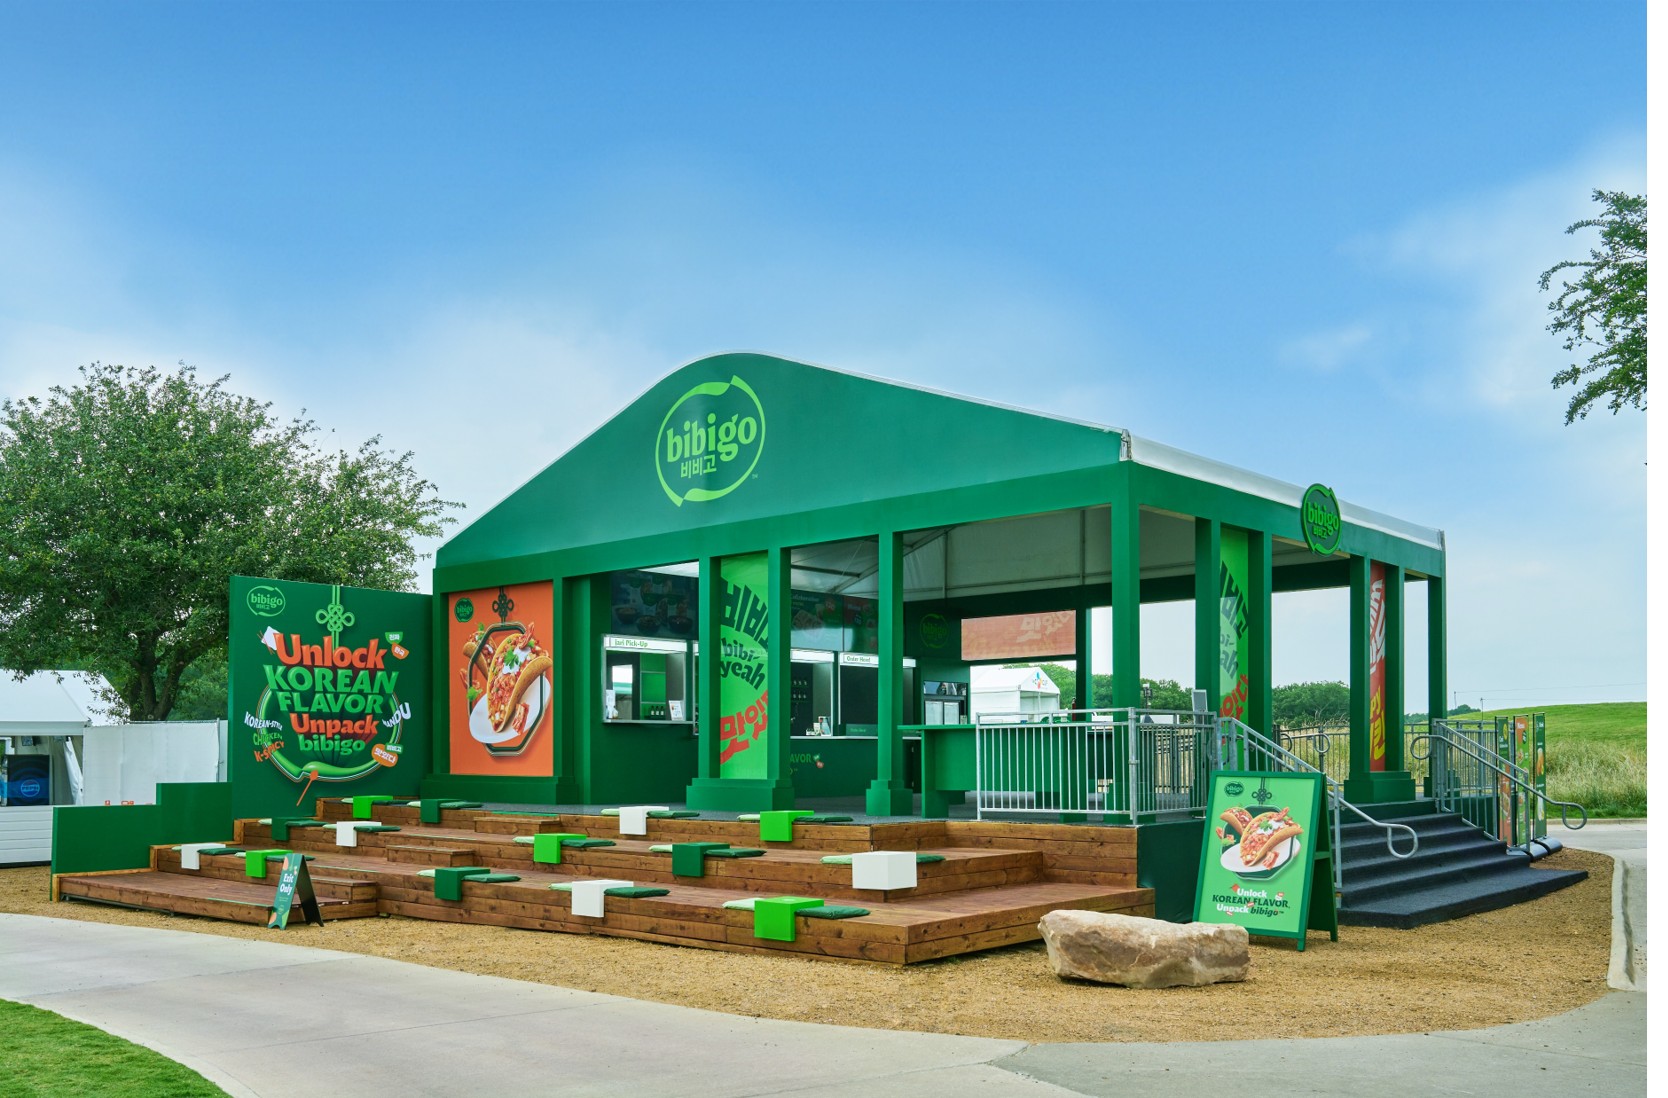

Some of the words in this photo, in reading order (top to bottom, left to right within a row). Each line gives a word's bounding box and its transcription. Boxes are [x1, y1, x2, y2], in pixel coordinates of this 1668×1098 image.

[667, 413, 757, 462] bibigo
[681, 454, 717, 478] 비비고
[1307, 502, 1339, 535] bibigo
[251, 593, 283, 608] bibigo
[273, 633, 387, 669] Unlock
[263, 664, 399, 694] KOREAN
[720, 660, 765, 690] yeah
[277, 692, 384, 713] FLAVOR
[290, 713, 379, 738] Unpack
[253, 733, 283, 746] CHICKEN
[297, 734, 366, 755] bibigo
[254, 741, 285, 763] K-SPICY
[283, 873, 294, 883] Exit
[280, 883, 293, 896] Only
[1212, 894, 1250, 904] KOREAN
[1237, 888, 1267, 898] Unlock
[1216, 903, 1249, 913] Unpack
